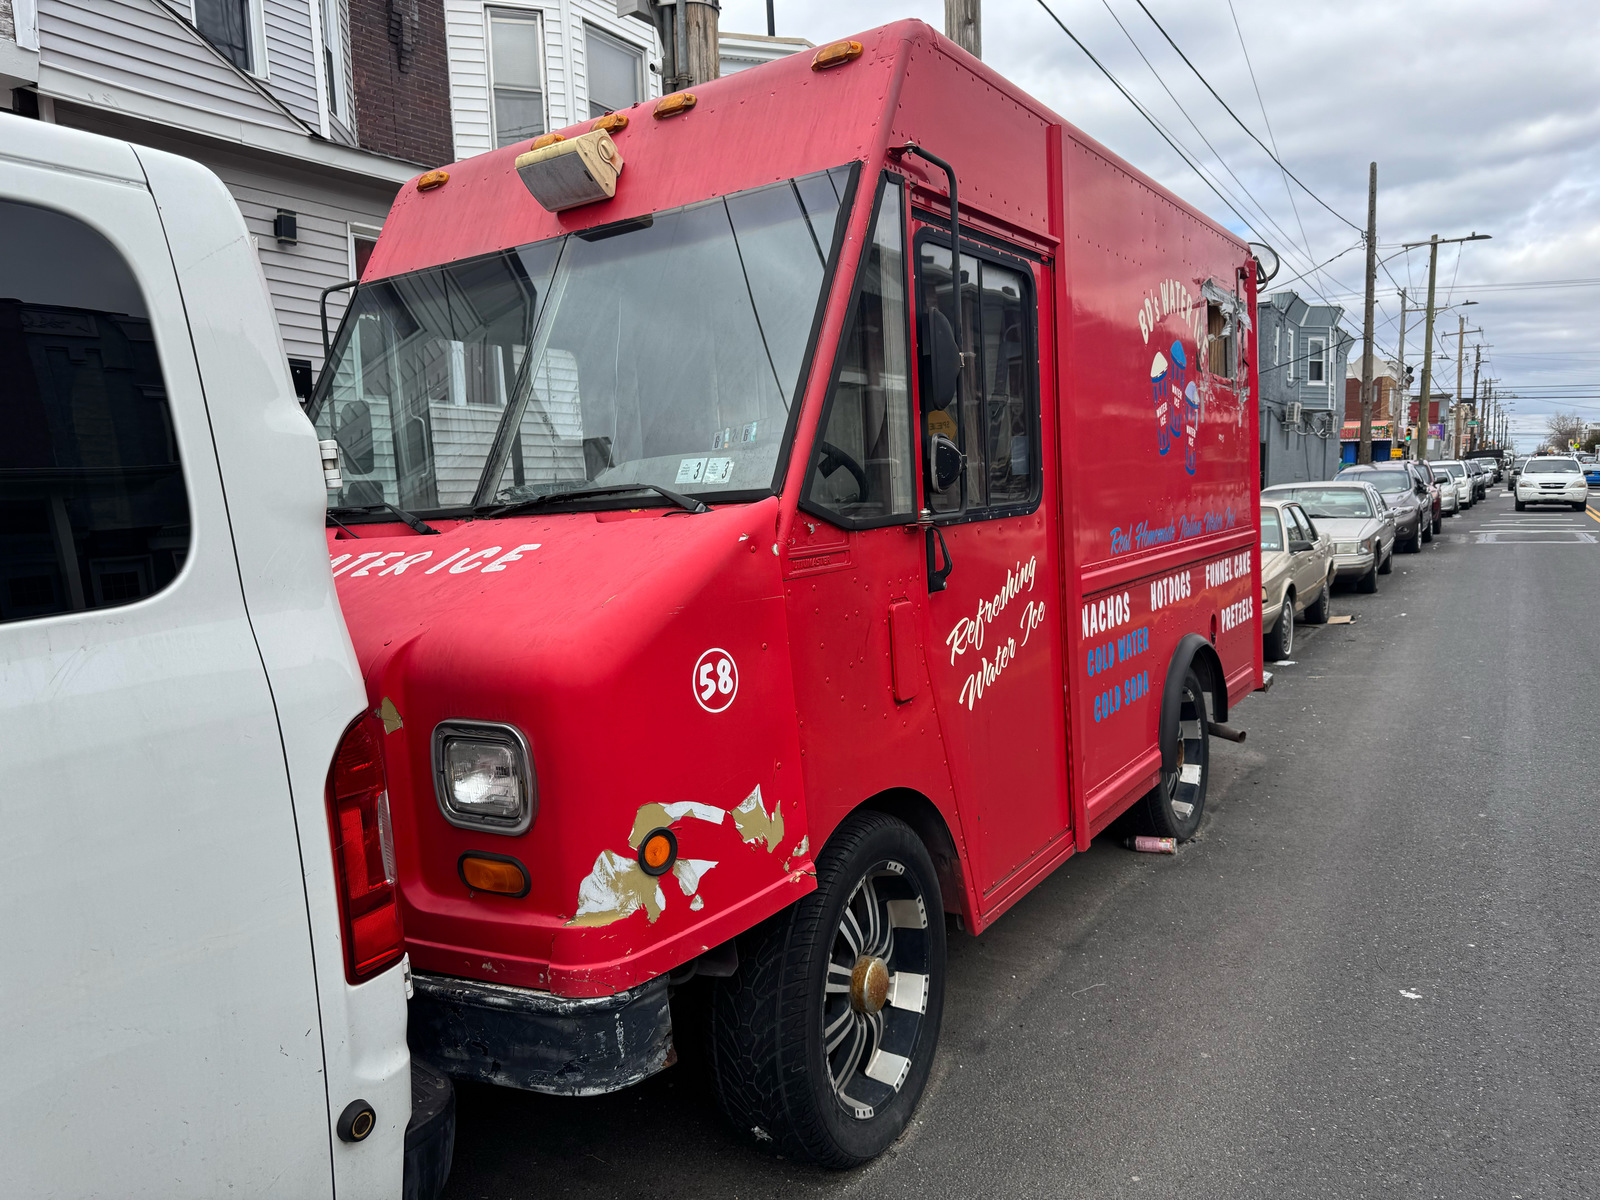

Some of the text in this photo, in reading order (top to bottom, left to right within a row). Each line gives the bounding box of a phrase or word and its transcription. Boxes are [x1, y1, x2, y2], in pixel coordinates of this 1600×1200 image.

[1160, 278, 1192, 328] WATER
[1341, 428, 1356, 438] CERY
[693, 461, 702, 480] 3
[721, 460, 730, 479] 3
[1110, 523, 1132, 555] Real
[1135, 516, 1175, 550] Homemade
[425, 543, 541, 575] ICE
[946, 555, 1036, 666] Refreshing
[1082, 551, 1250, 640] NACHOS HOTDOGS FUNNEL CAKE
[1221, 596, 1253, 633] PRETZELS
[959, 601, 1045, 711] Water Ice
[1088, 627, 1149, 677] COLD WATER
[700, 658, 733, 701] 58
[1095, 670, 1149, 722] COLD SODA
